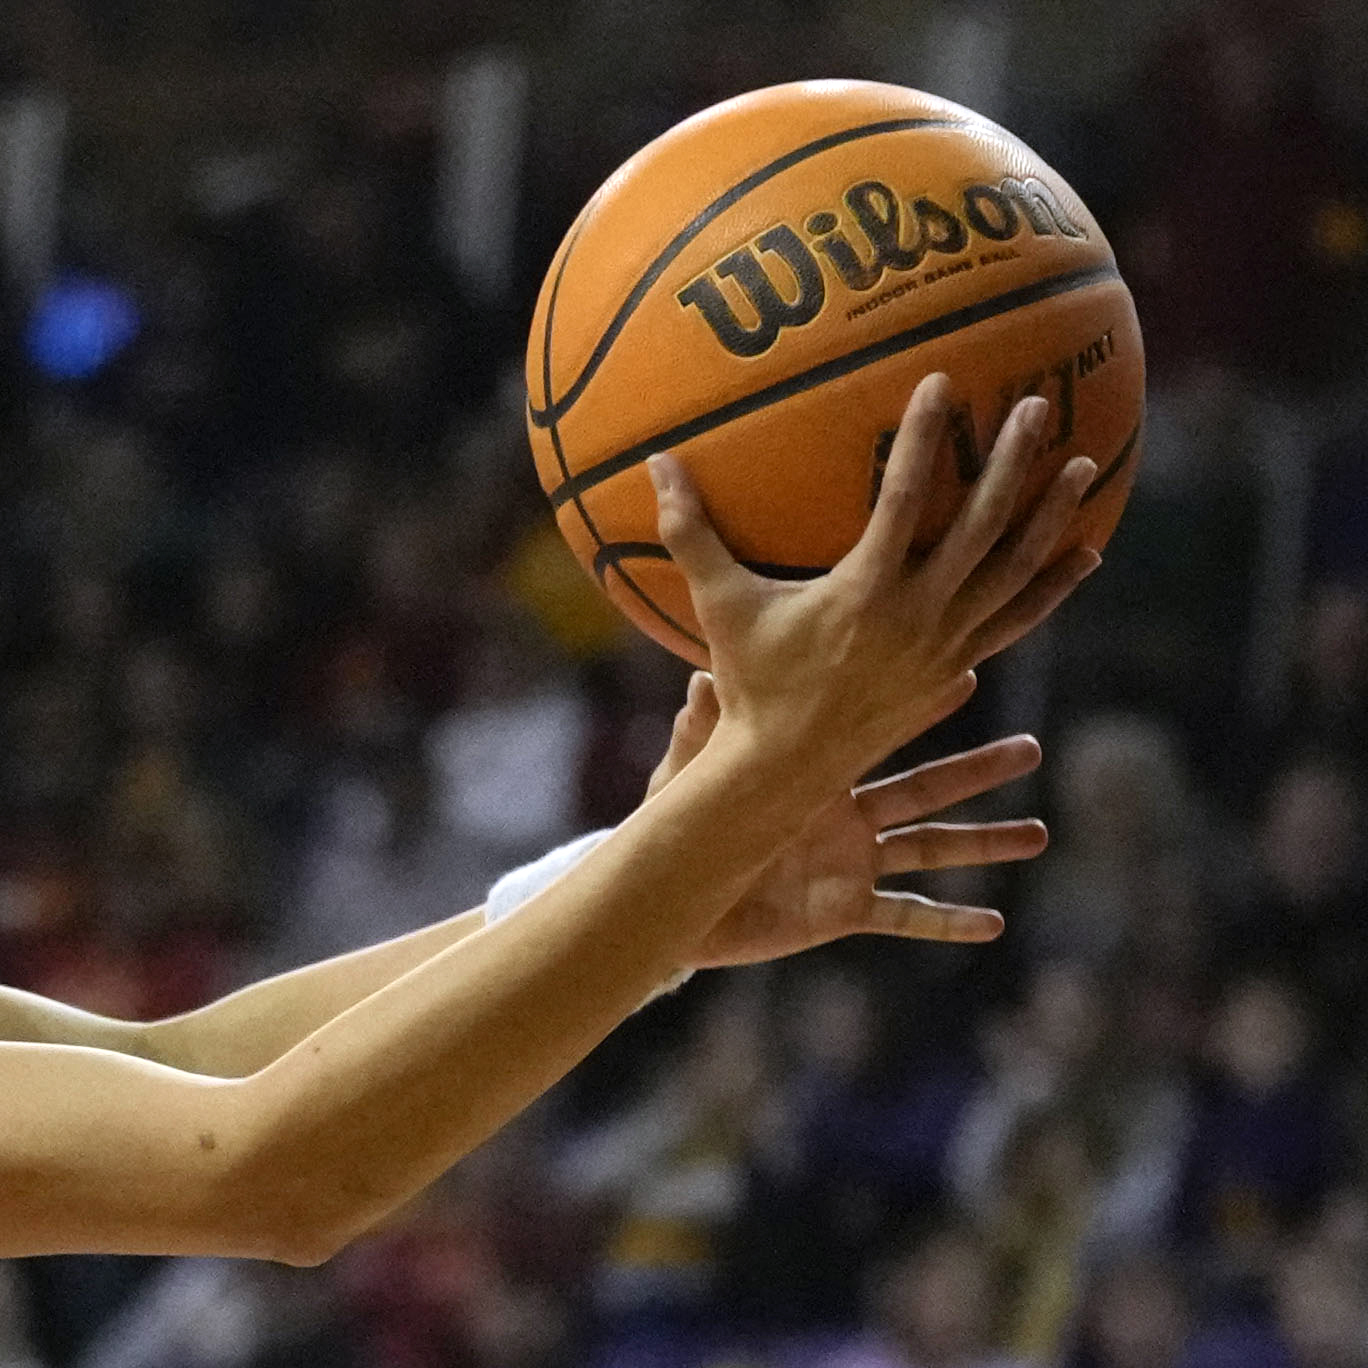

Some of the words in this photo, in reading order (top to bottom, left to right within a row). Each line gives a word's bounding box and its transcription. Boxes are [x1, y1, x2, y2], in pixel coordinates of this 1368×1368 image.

[674, 178, 1089, 358] Wilson
[846, 278, 919, 322] INDOOR
[924, 259, 973, 285] GAME
[1075, 329, 1114, 378] NXT
